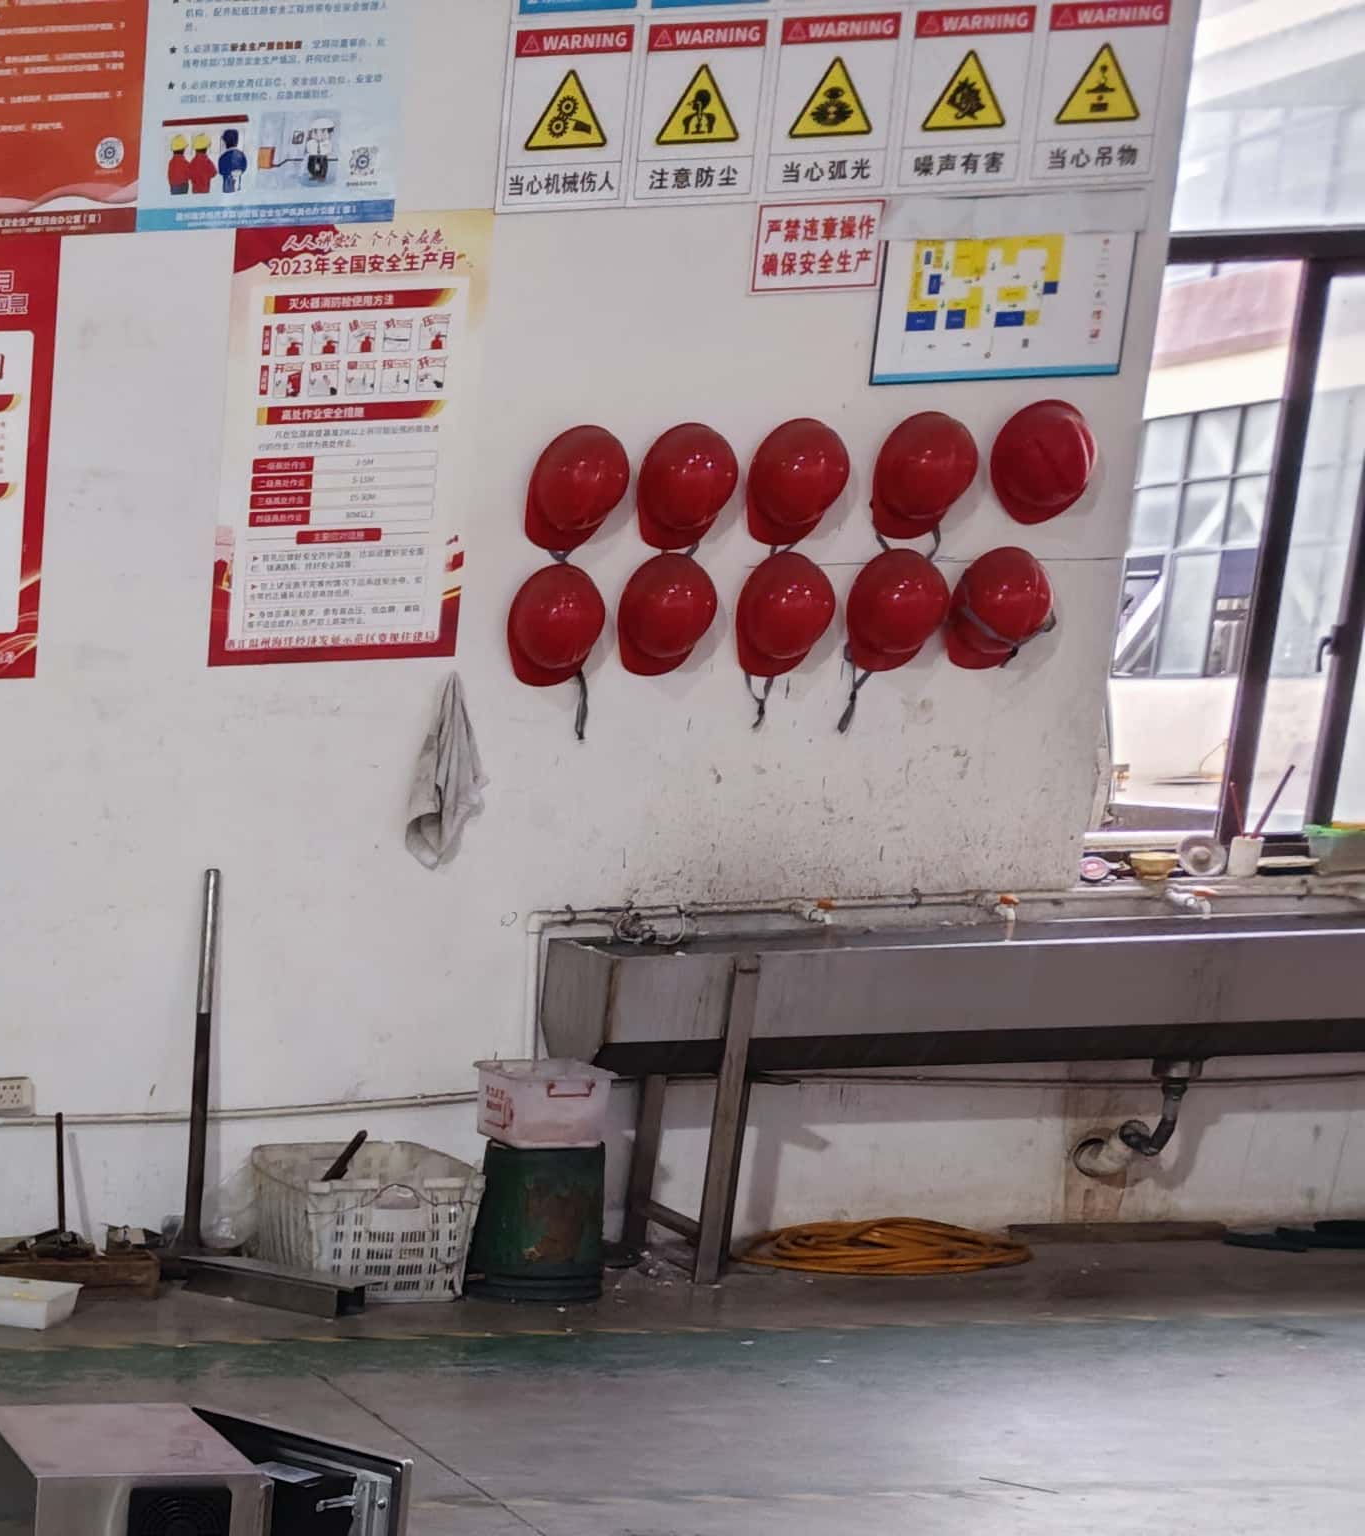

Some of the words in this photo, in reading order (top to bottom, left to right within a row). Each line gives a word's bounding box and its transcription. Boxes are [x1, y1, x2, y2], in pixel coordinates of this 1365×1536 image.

[941, 13, 1029, 32] WARNING
[1077, 5, 1164, 25] WARNING
[542, 31, 627, 51] WARNING
[675, 26, 761, 45] WARNING
[808, 19, 895, 39] WARNING
[913, 151, 1006, 177] 噪声有害
[1047, 143, 1139, 170] 当心吊物
[508, 170, 615, 197] 当心机械伤人
[649, 165, 739, 191] 注意防尘
[781, 158, 872, 184] 当心弧光
[764, 214, 876, 243] 严禁违章操作
[269, 251, 455, 276] 2023年全国安全生产月
[761, 247, 874, 278] 确保安全生产
